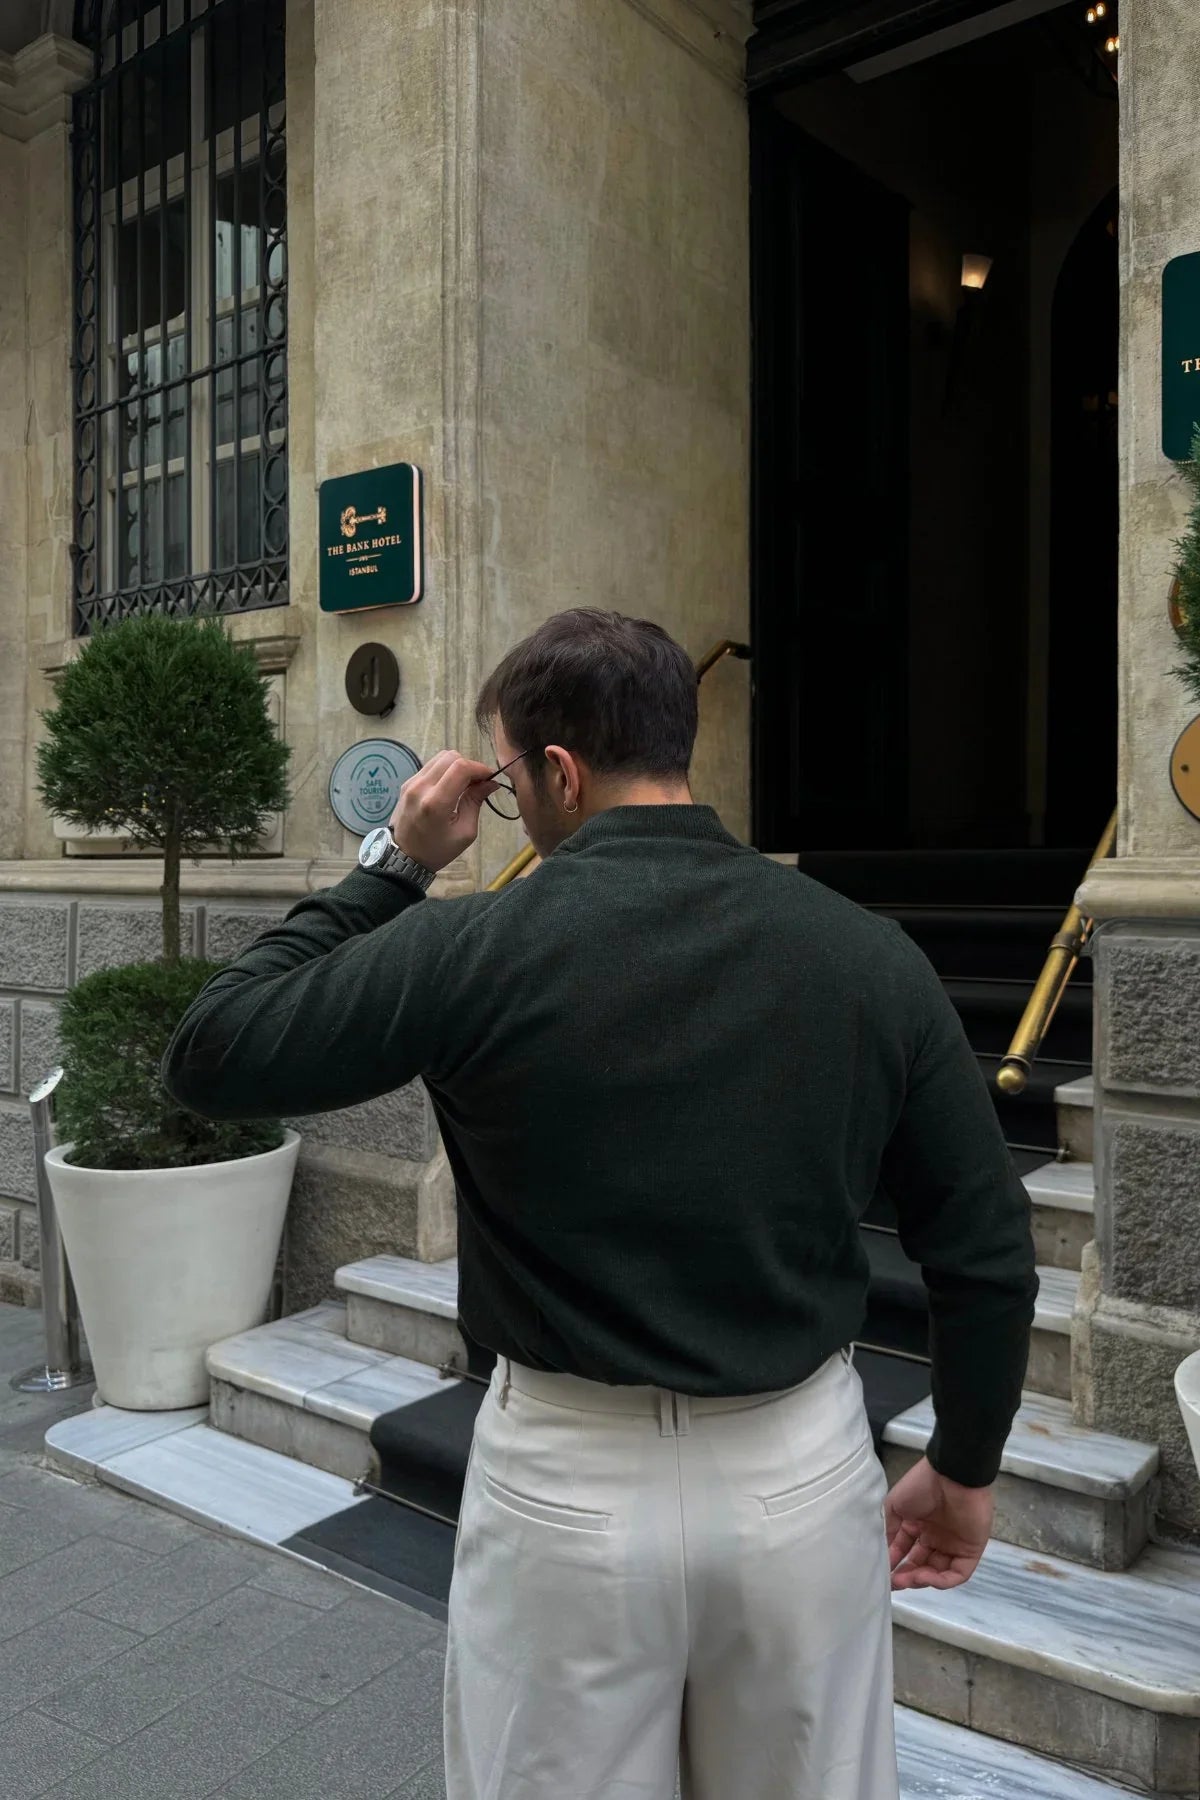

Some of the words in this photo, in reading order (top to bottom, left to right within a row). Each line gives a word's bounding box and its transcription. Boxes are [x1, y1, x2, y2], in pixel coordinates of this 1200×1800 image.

[327, 545, 344, 556] THE
[346, 540, 369, 553] BANK
[372, 534, 401, 548] HOTEL
[349, 565, 378, 576] ISTANBUL
[360, 787, 389, 795] TOURISM
